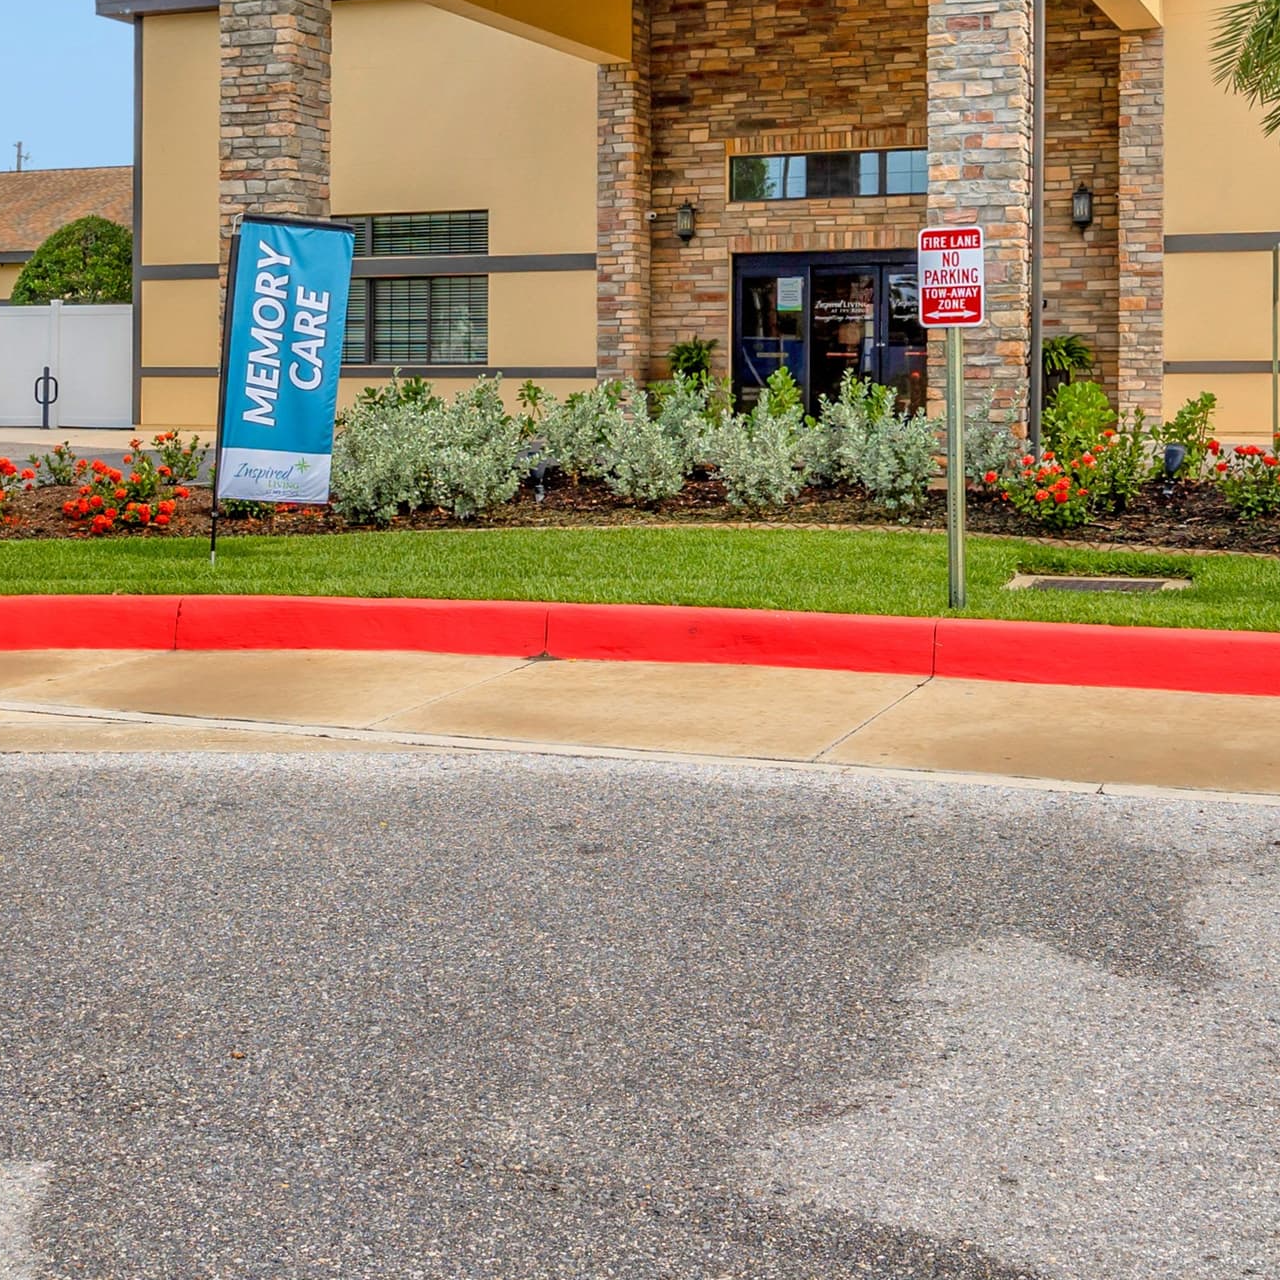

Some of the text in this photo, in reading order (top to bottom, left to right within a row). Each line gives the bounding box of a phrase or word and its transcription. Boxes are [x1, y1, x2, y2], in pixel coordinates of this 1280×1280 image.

[923, 234, 979, 249] FIRE LANE
[942, 251, 960, 267] NO
[924, 268, 978, 285] PARKING
[925, 287, 978, 299] TOW-AWAY
[938, 299, 966, 310] ZONE
[242, 240, 291, 426] MEMORY
[288, 285, 330, 391] CARE
[233, 462, 294, 484] Inspired
